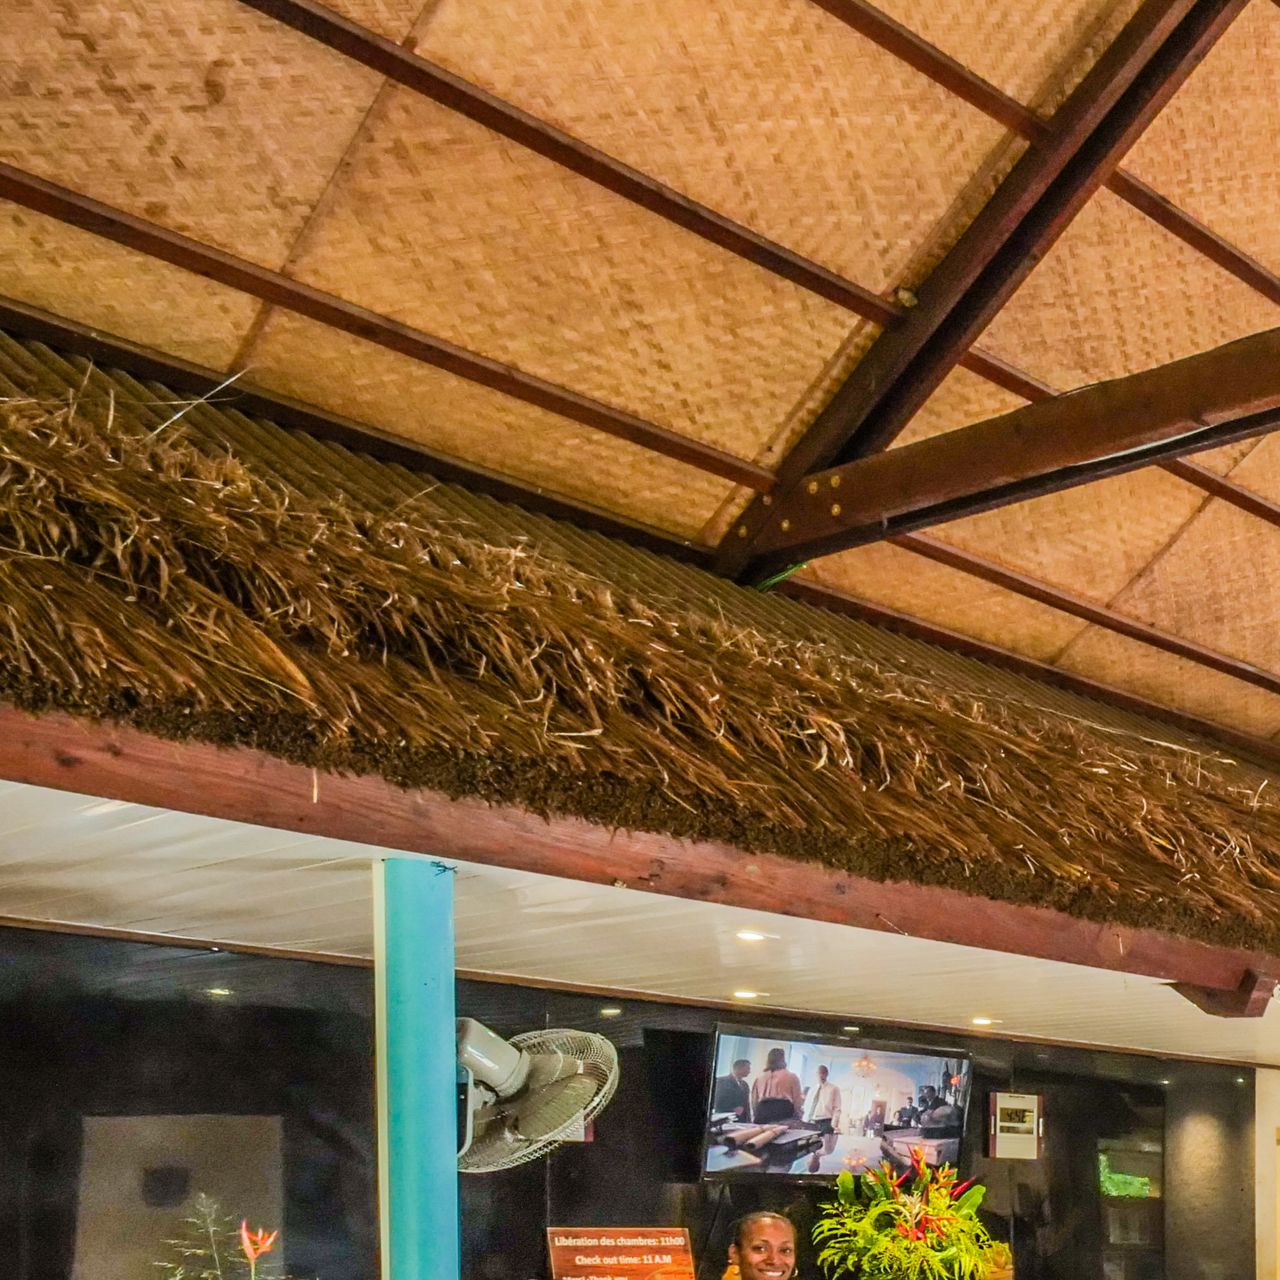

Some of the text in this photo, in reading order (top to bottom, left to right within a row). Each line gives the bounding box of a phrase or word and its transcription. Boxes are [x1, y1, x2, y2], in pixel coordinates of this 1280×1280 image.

[554, 1236, 685, 1246] Libération des chambres: 11h00
[575, 1255, 601, 1265] Check
[602, 1256, 618, 1265] out
[619, 1255, 641, 1265] time:
[643, 1255, 653, 1264] 11
